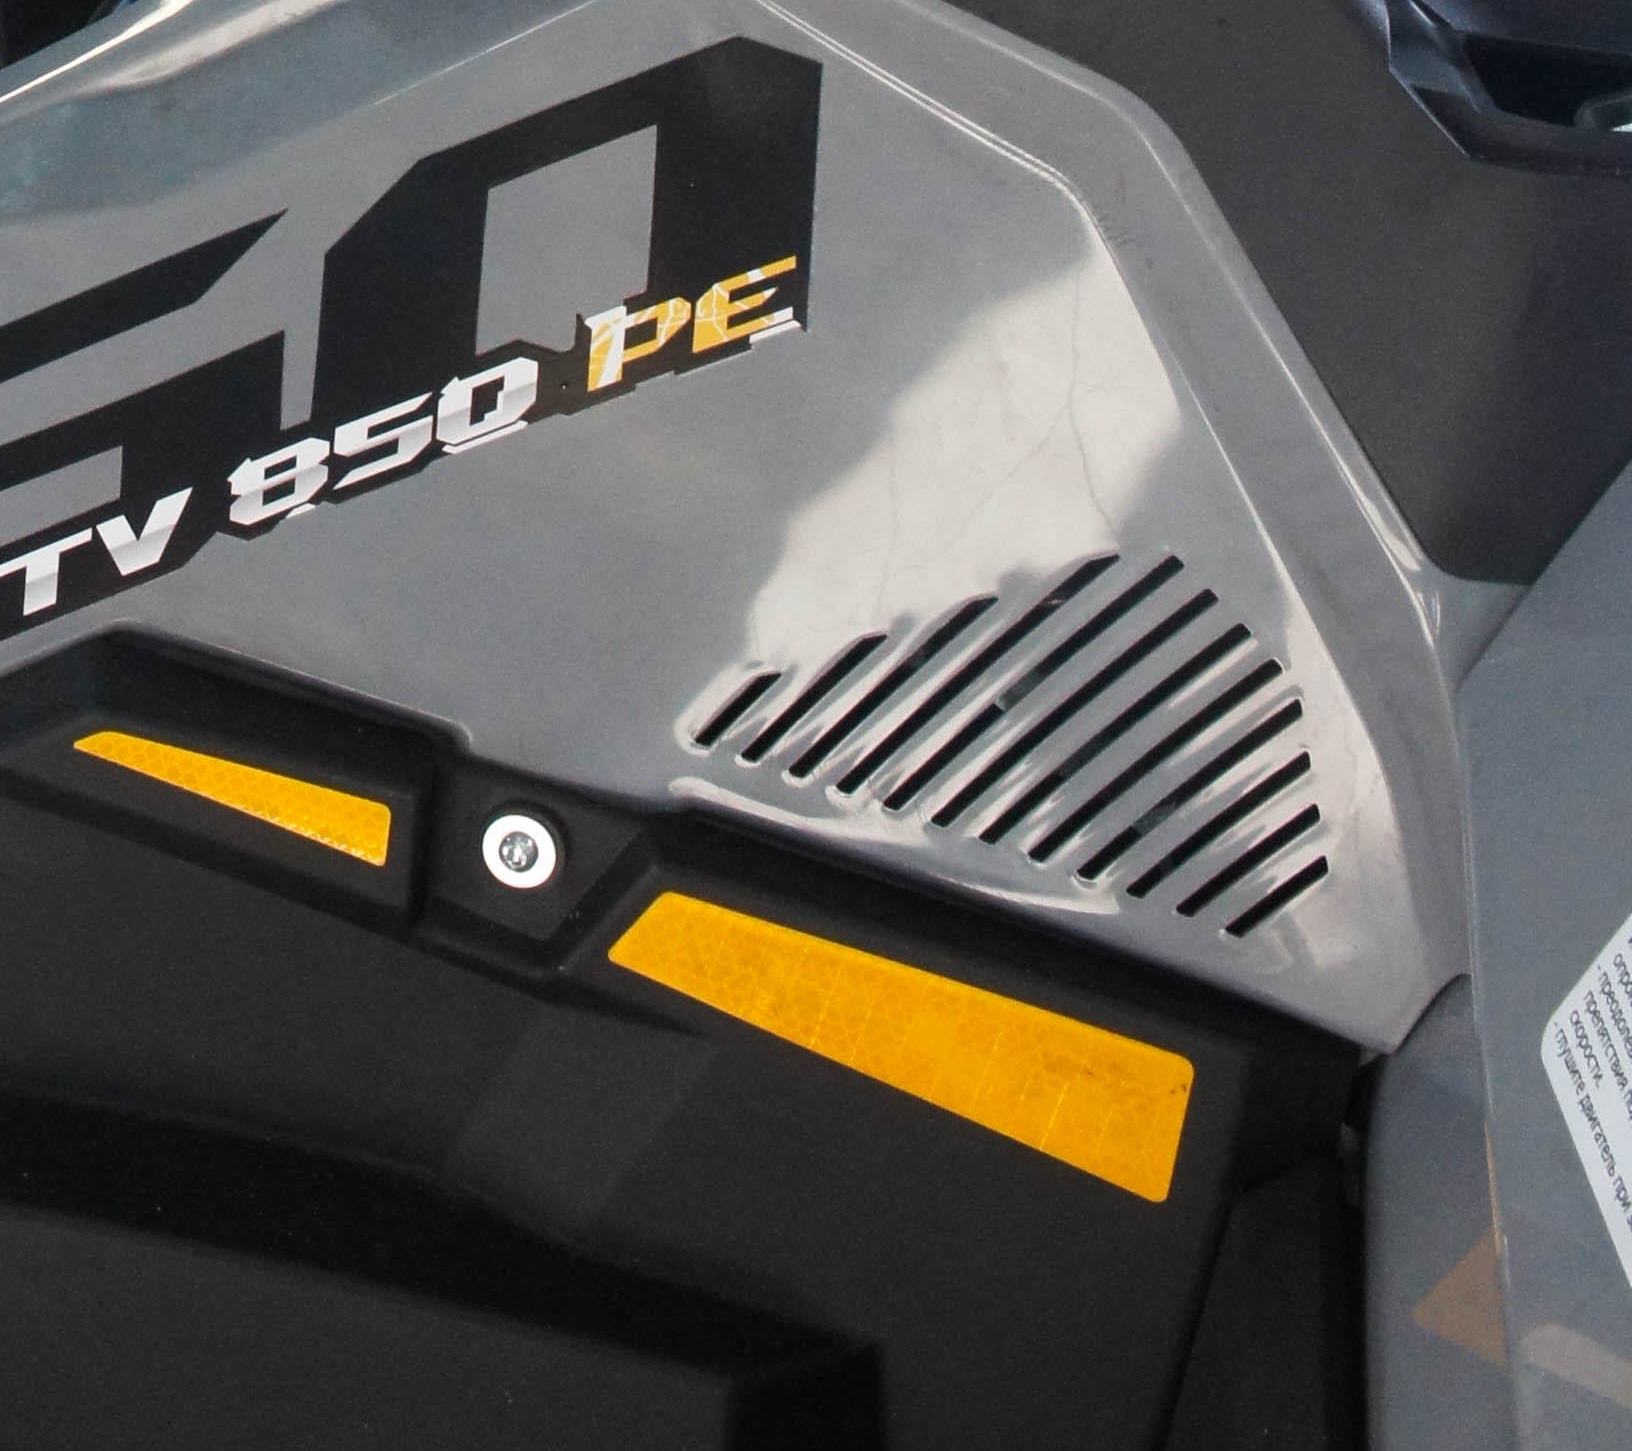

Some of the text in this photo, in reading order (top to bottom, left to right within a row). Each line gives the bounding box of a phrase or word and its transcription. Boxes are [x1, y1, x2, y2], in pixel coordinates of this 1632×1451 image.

[226, 355, 538, 523] 850
[583, 256, 802, 392] PE
[1578, 1094, 1616, 1177] двигатель
